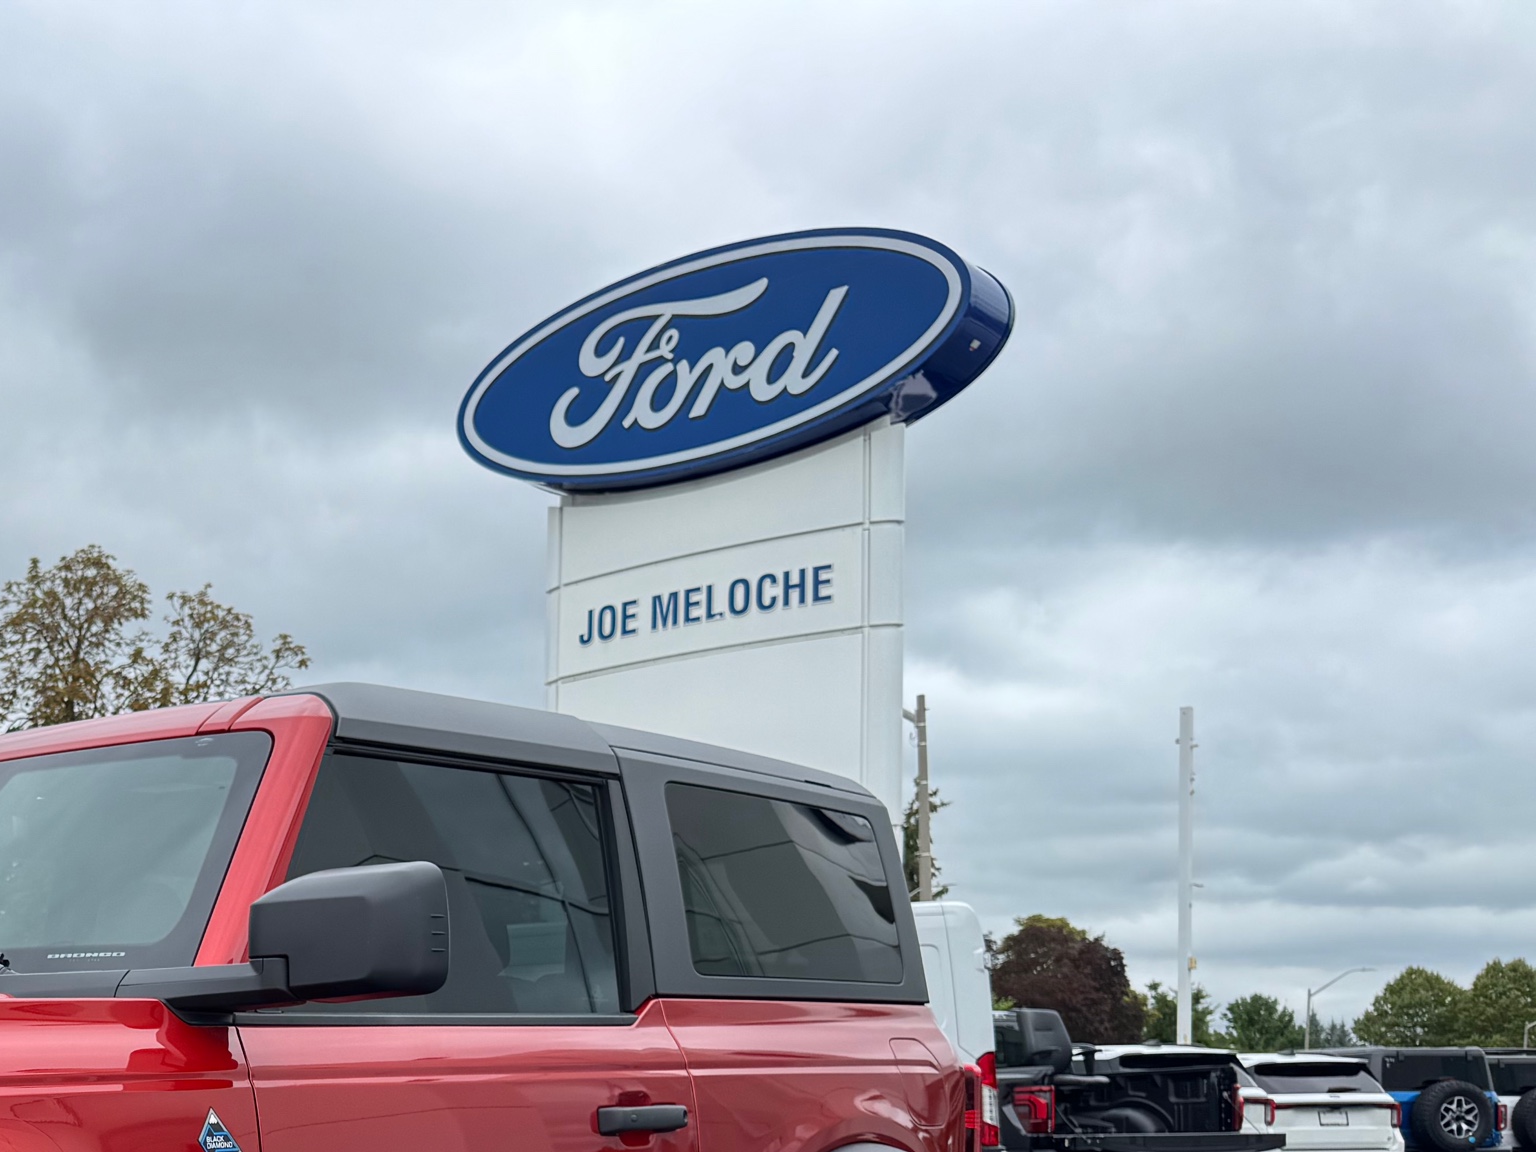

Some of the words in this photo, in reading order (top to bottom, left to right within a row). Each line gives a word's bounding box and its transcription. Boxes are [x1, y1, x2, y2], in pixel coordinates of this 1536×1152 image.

[549, 277, 849, 449] Ford
[578, 600, 638, 647] JOE
[651, 564, 834, 633] MELOCHE
[206, 1141, 233, 1149] DIAMOND
